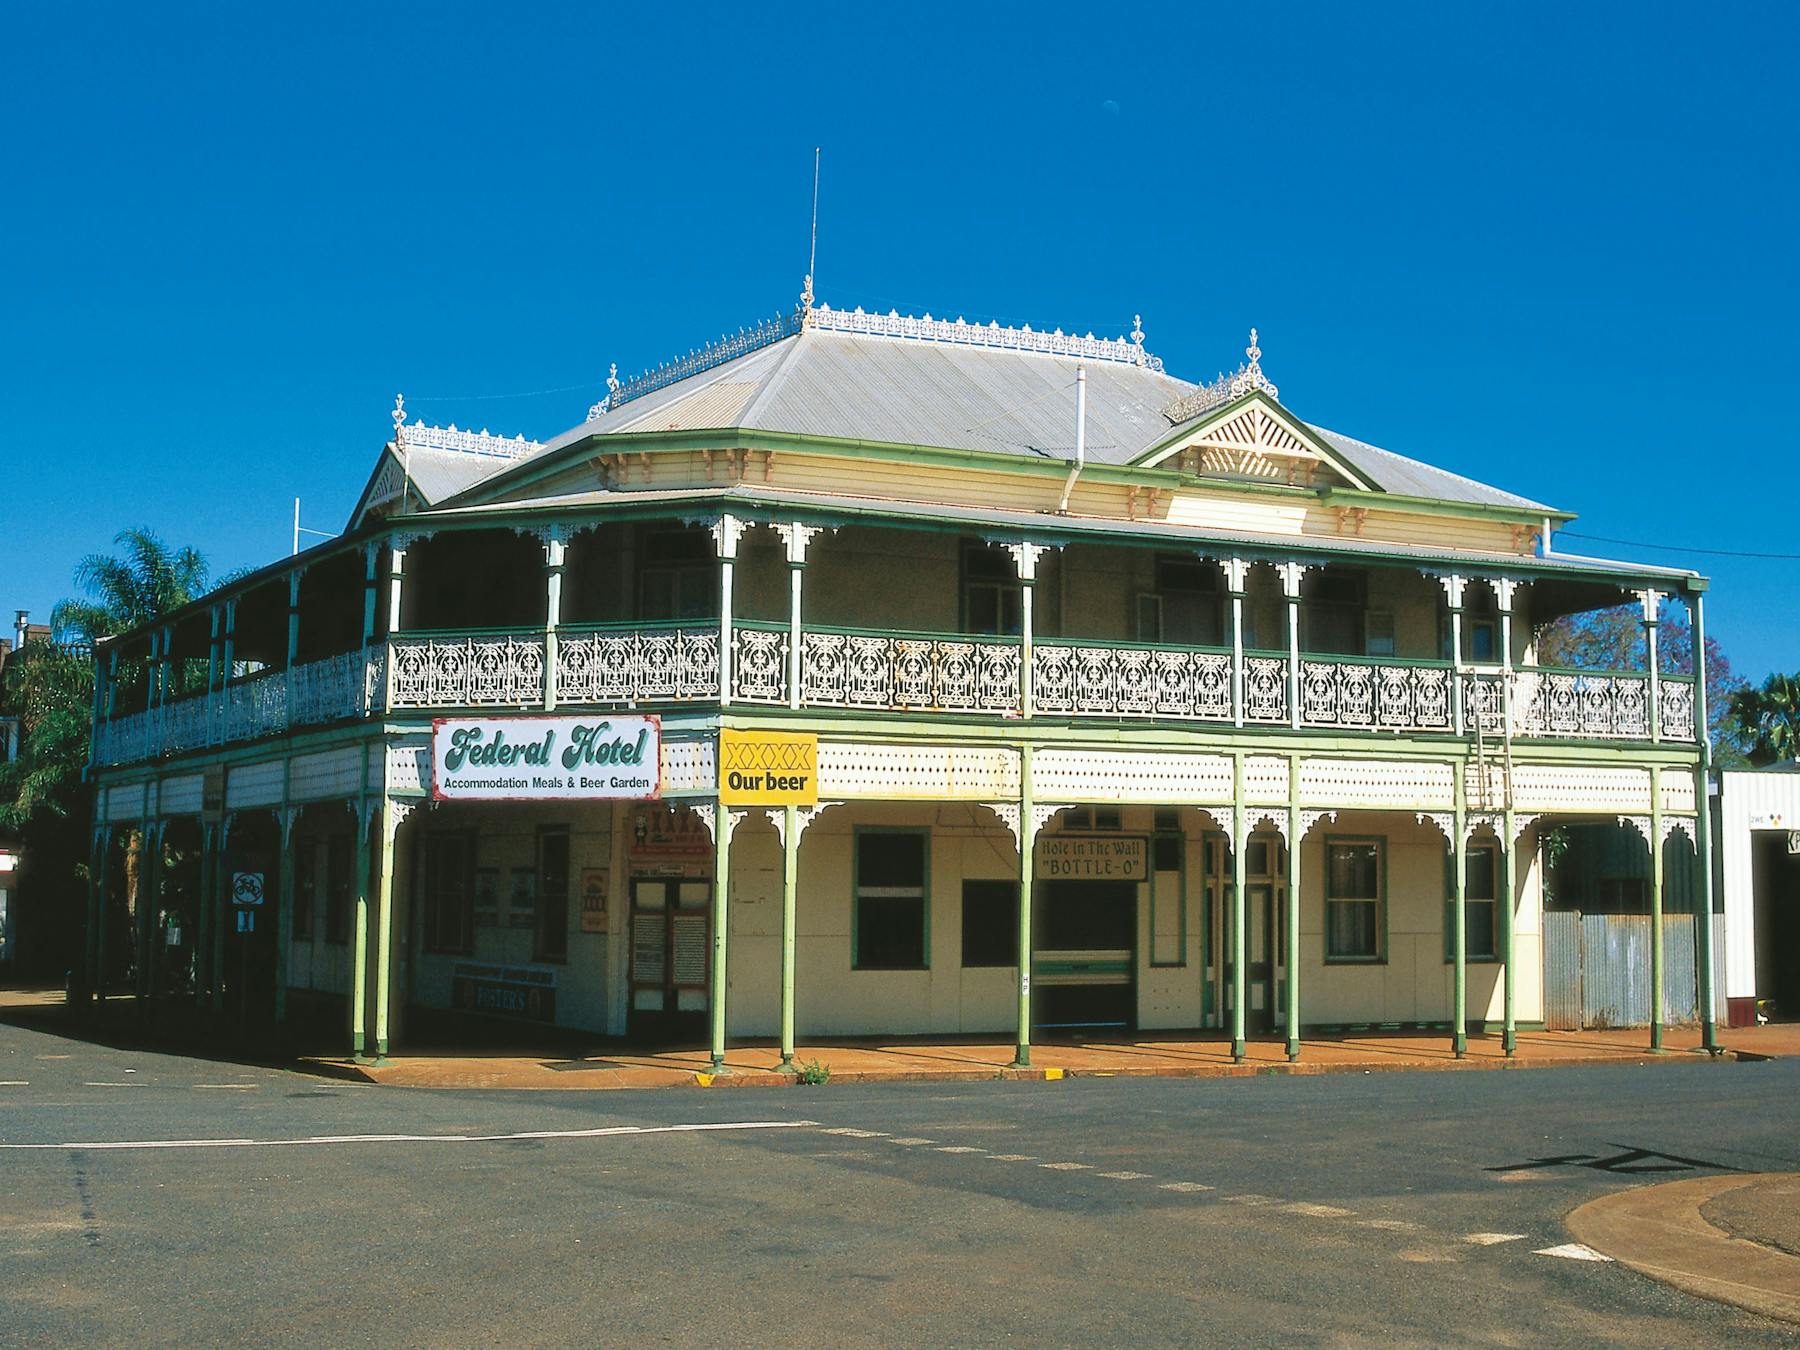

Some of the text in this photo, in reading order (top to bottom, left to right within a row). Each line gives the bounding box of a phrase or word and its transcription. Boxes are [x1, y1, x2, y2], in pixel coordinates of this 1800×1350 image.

[445, 721, 649, 772] Federal Hotel
[726, 742, 811, 770] XXXX
[444, 776, 650, 789] Accommodation Meals & Beer Garden
[728, 771, 808, 791] Our beer
[1042, 841, 1140, 855] Hole In The Wall
